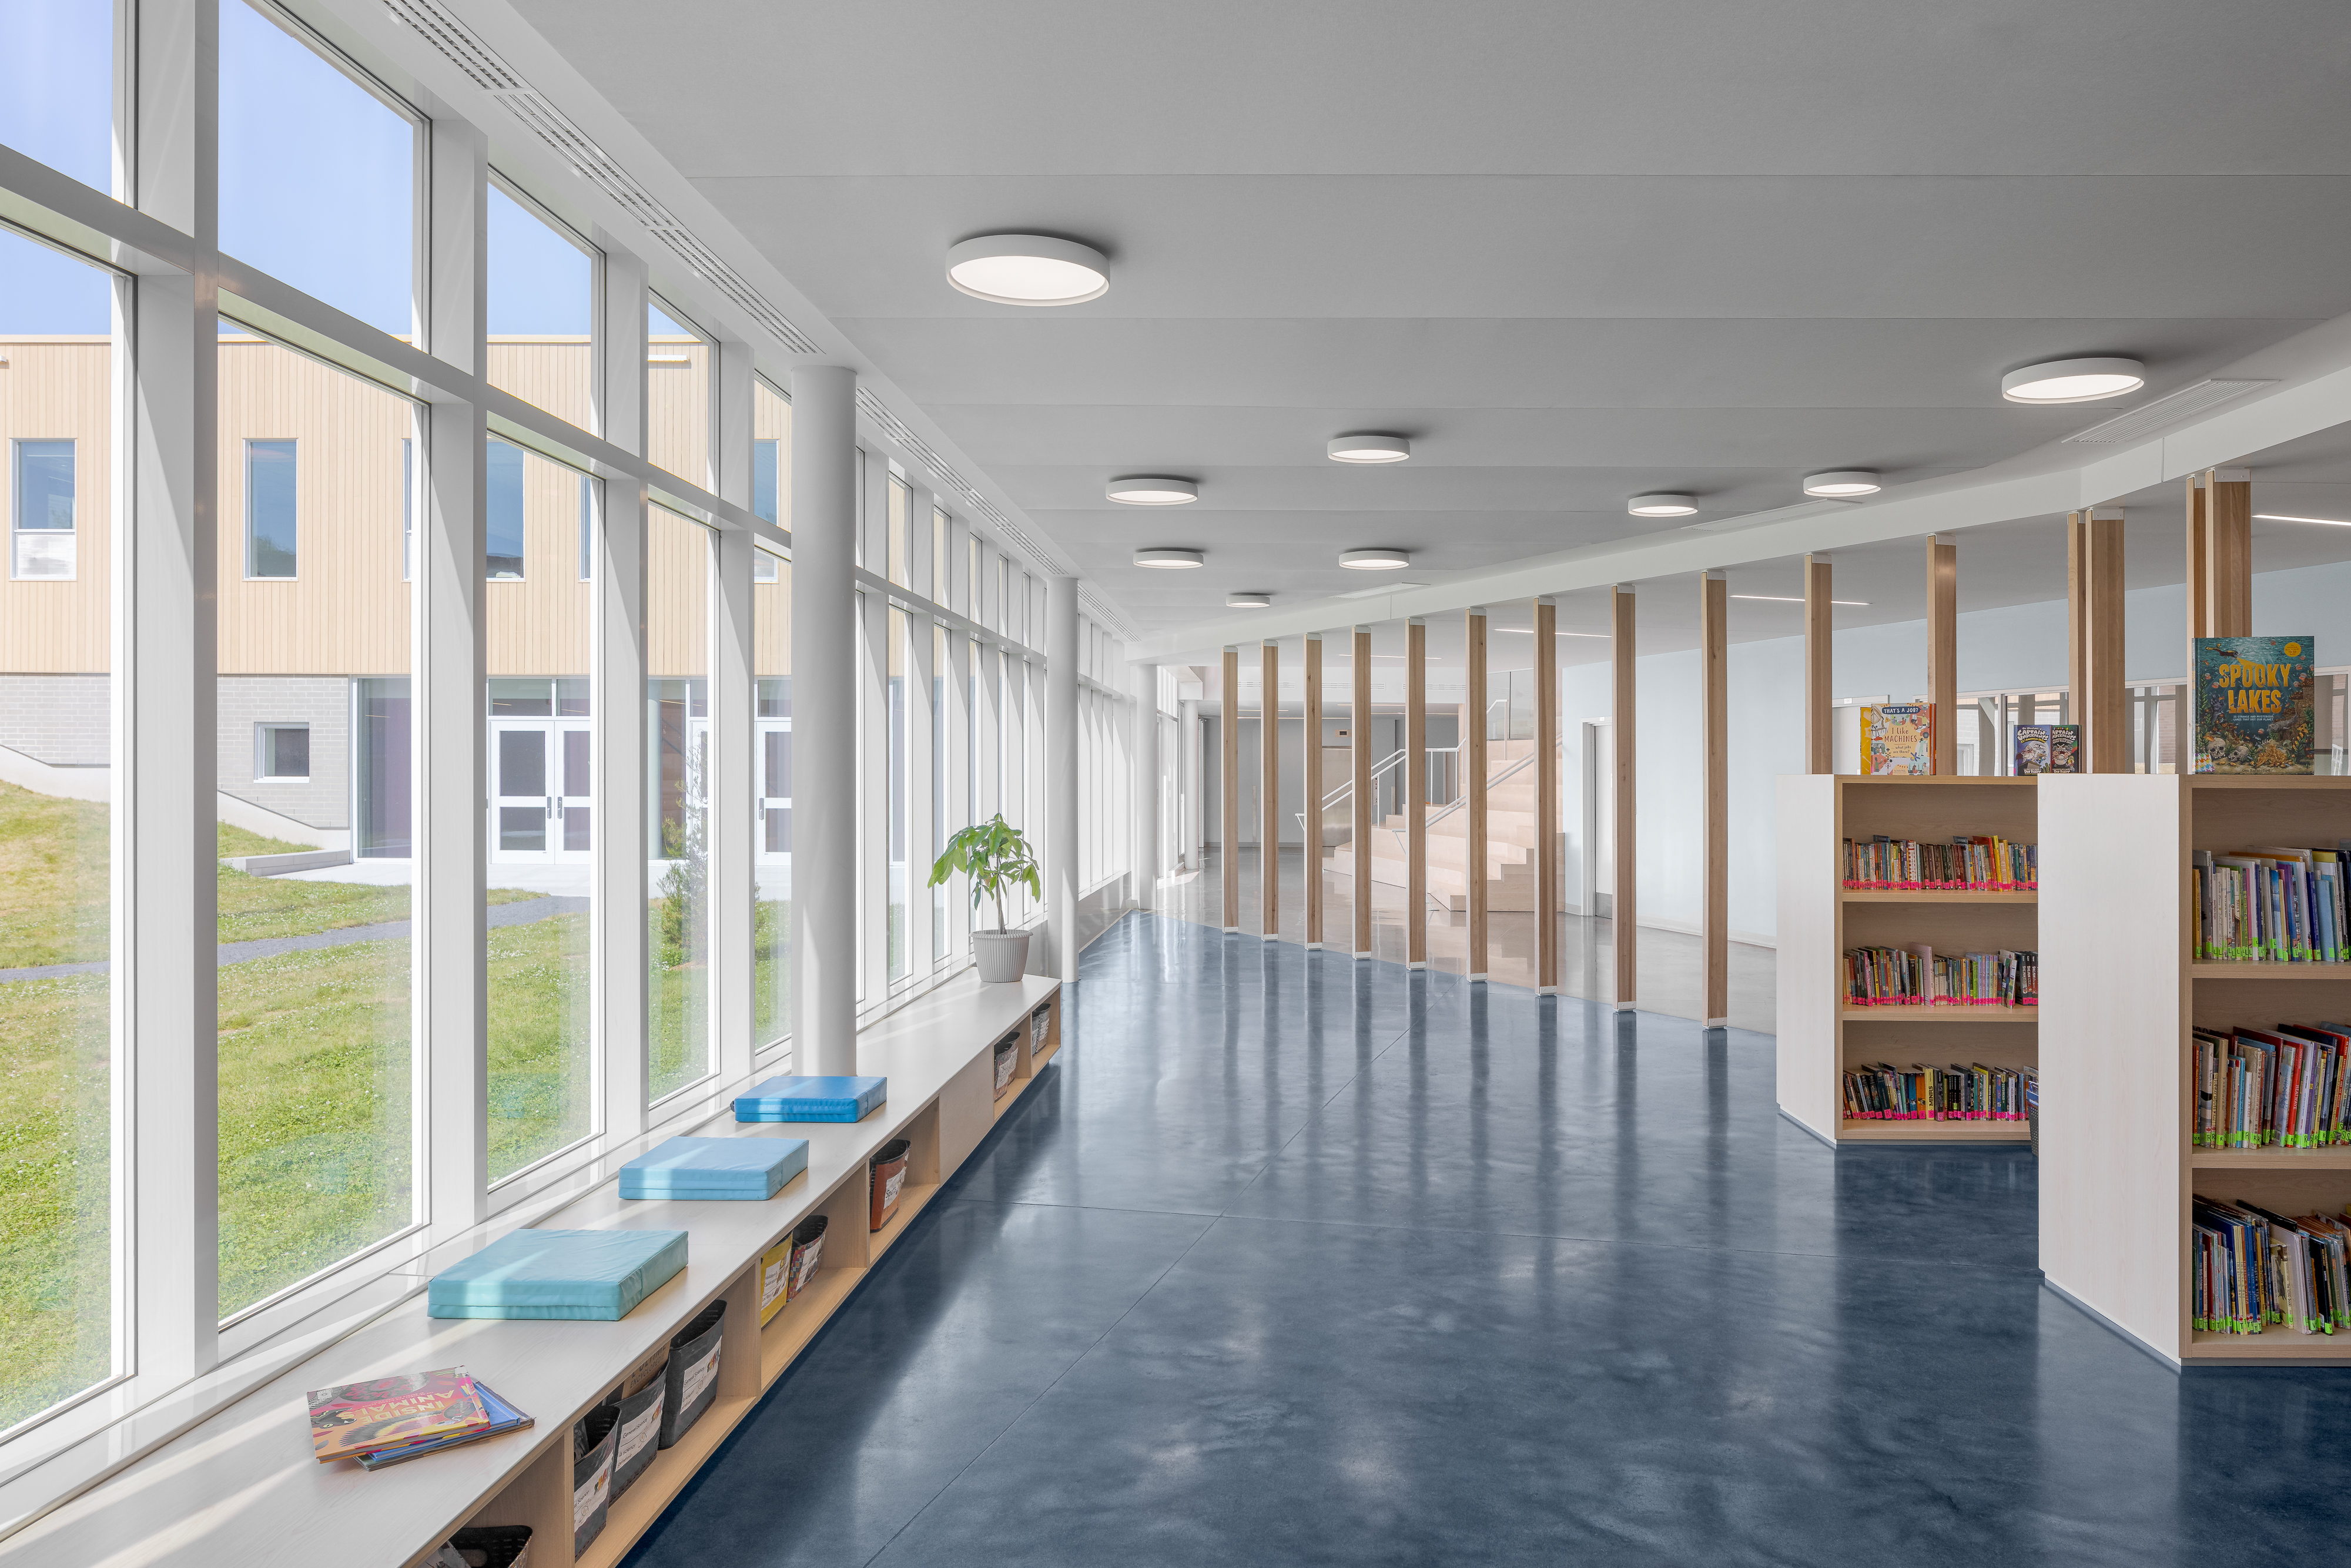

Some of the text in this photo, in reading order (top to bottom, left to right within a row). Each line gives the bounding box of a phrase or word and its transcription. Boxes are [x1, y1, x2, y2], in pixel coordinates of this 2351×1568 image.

[2219, 664, 2291, 688] SPOOKY
[2228, 689, 2282, 713] LAKES
[2342, 1131, 2345, 1139] S
[886, 1186, 897, 1200] Sports
[684, 1366, 705, 1386] General Science
[336, 1389, 454, 1420] ANIMALS
[358, 1400, 445, 1425] INSIDE
[623, 1418, 648, 1439] General Science
[623, 1443, 636, 1455] science
[578, 1490, 590, 1505] Science
